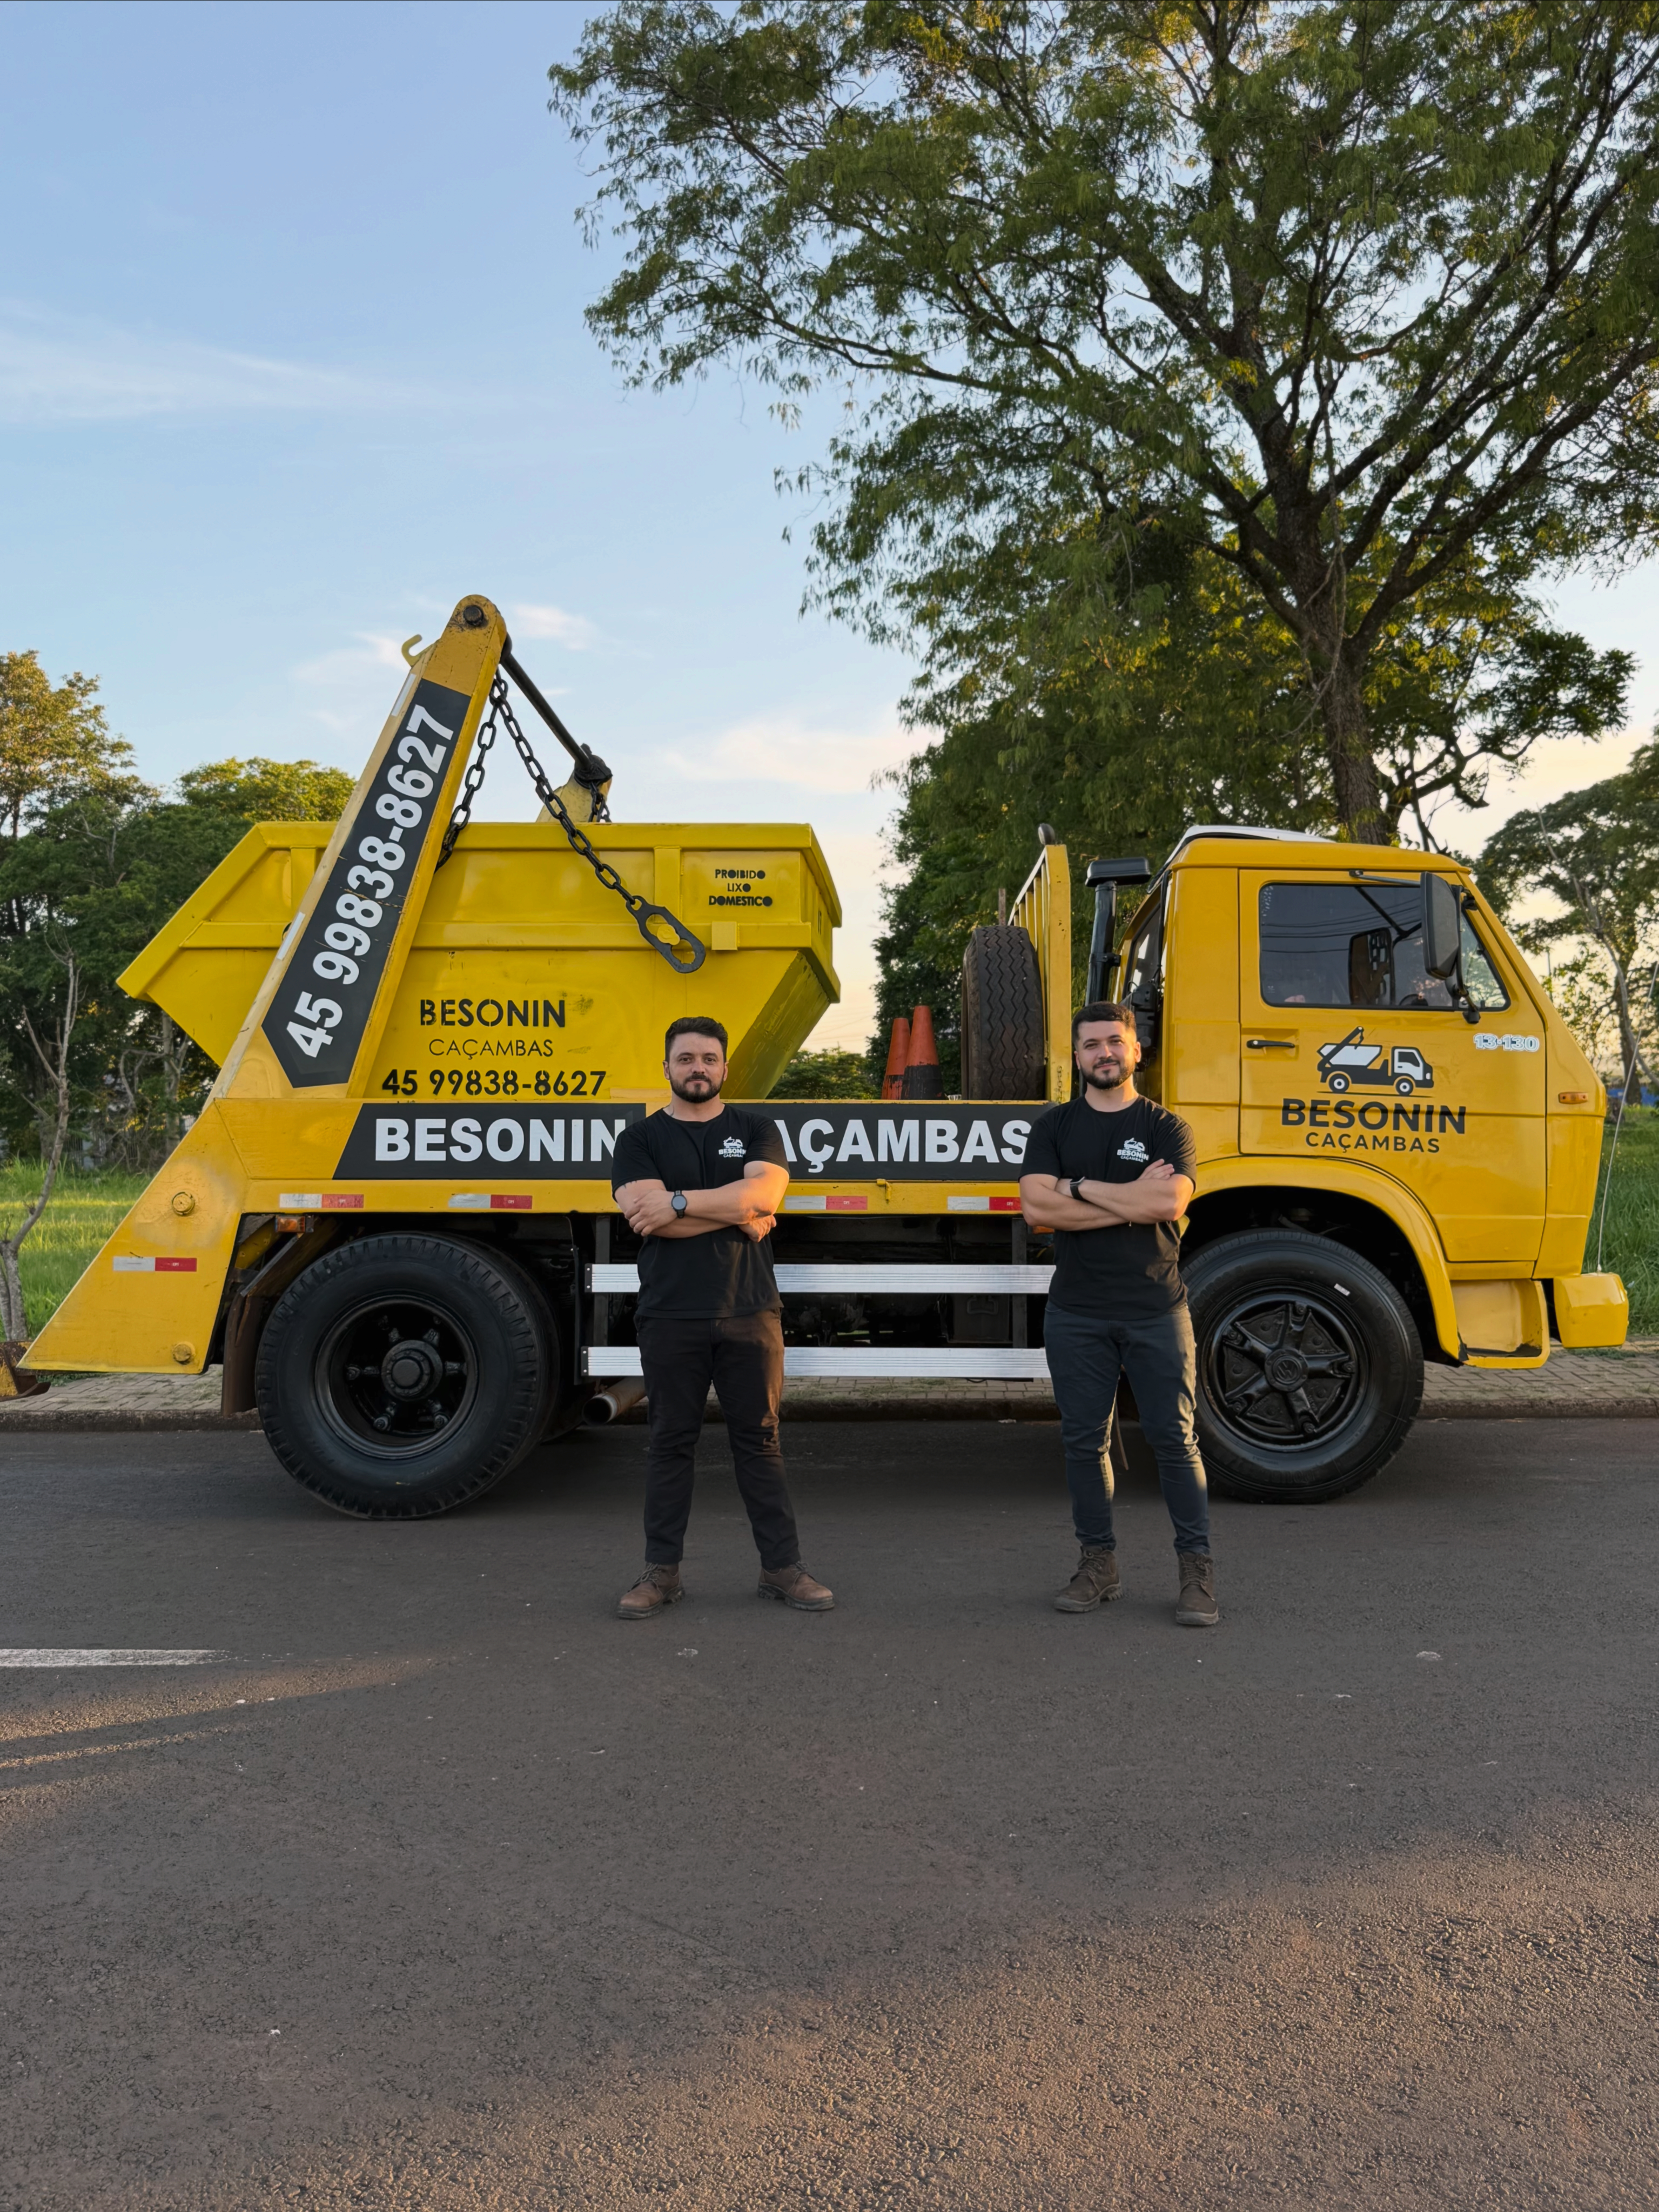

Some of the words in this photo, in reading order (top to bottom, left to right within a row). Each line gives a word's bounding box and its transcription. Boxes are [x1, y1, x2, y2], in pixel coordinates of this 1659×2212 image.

[312, 704, 454, 985] 99838-8627
[715, 869, 765, 879] PROIBIDO
[727, 883, 751, 892] LIXO
[708, 895, 773, 907] DOMESTICO
[286, 991, 343, 1058] 45
[420, 998, 566, 1028] BESONIN
[429, 1039, 554, 1060] CAÇAMBAS
[381, 1068, 418, 1096] 45
[429, 1069, 607, 1096] 99838-8627
[1281, 1098, 1467, 1135] BESONIN
[375, 1118, 626, 1162] BESONIN
[774, 1119, 1032, 1174] ÇAMBAS
[1117, 1149, 1149, 1161] BESONIN
[1305, 1132, 1440, 1154] CAÇAMBAS
